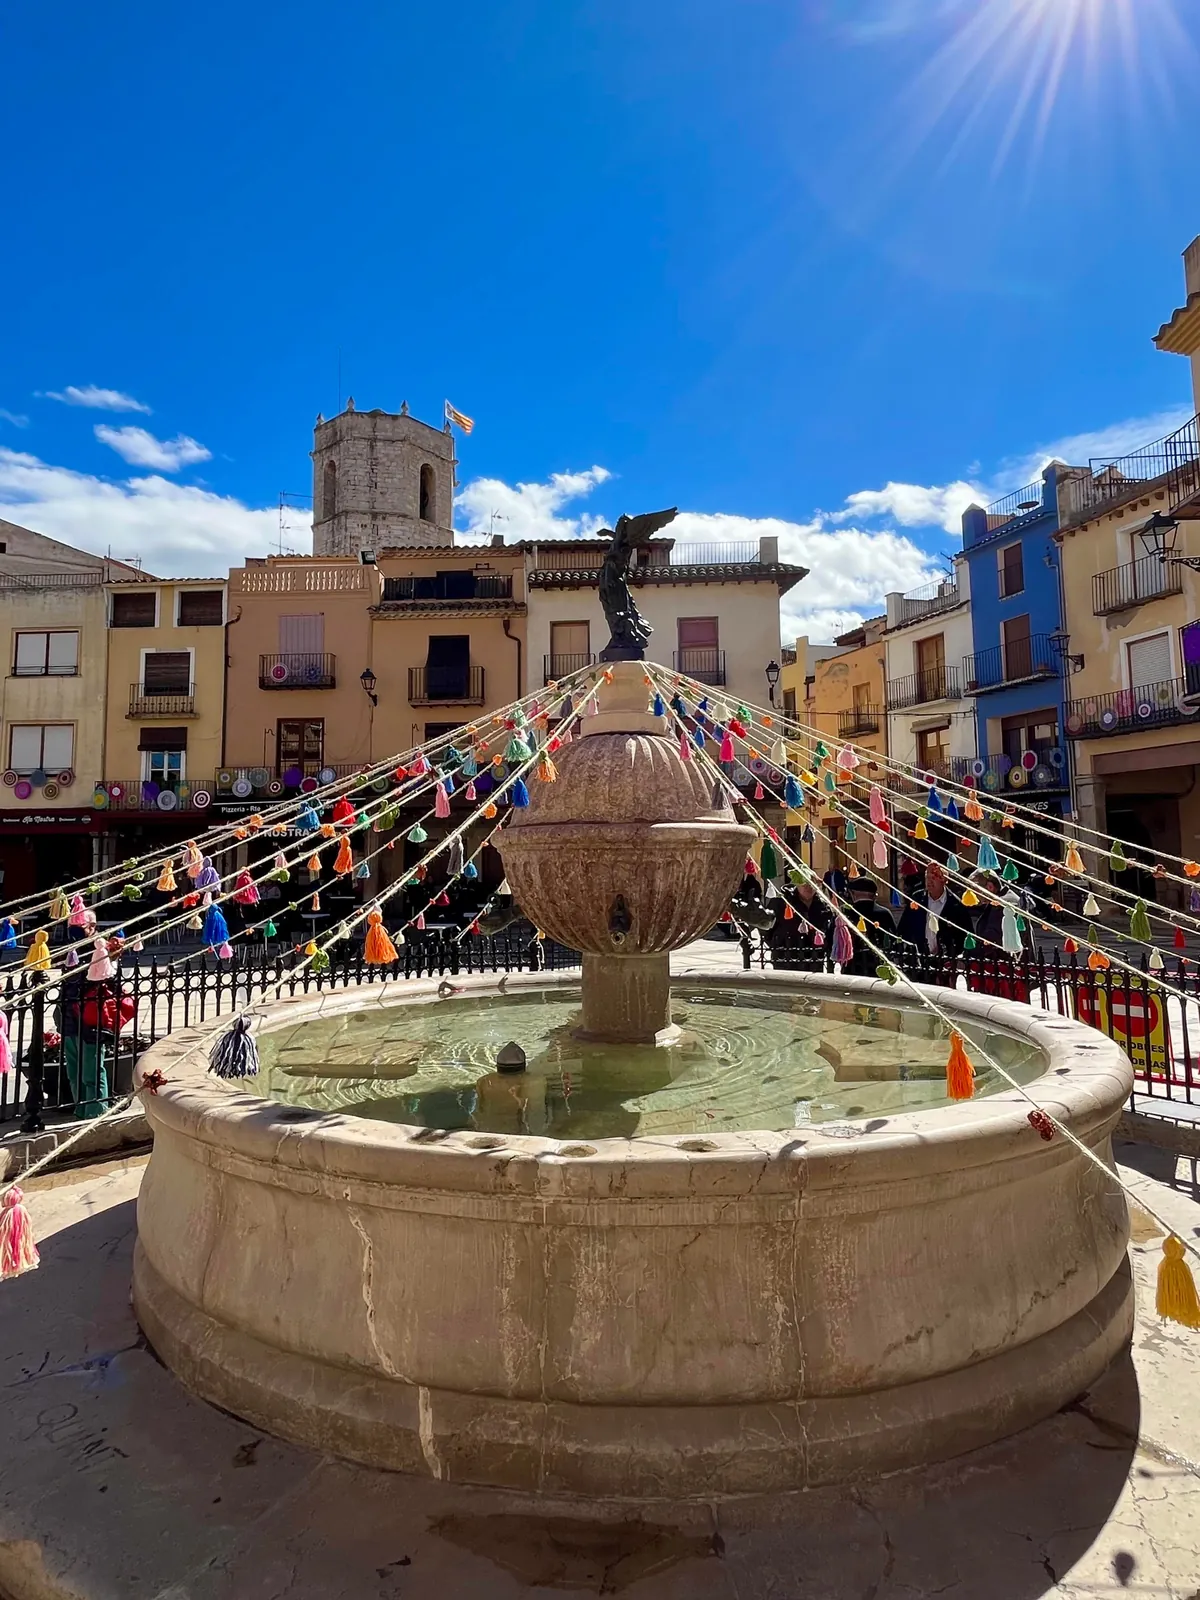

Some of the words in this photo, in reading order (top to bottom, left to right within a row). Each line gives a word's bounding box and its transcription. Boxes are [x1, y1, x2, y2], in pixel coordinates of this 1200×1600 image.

[264, 828, 309, 837] NOSTRA
[1130, 1041, 1165, 1053] OBES
[1132, 1057, 1166, 1069] OBAS
